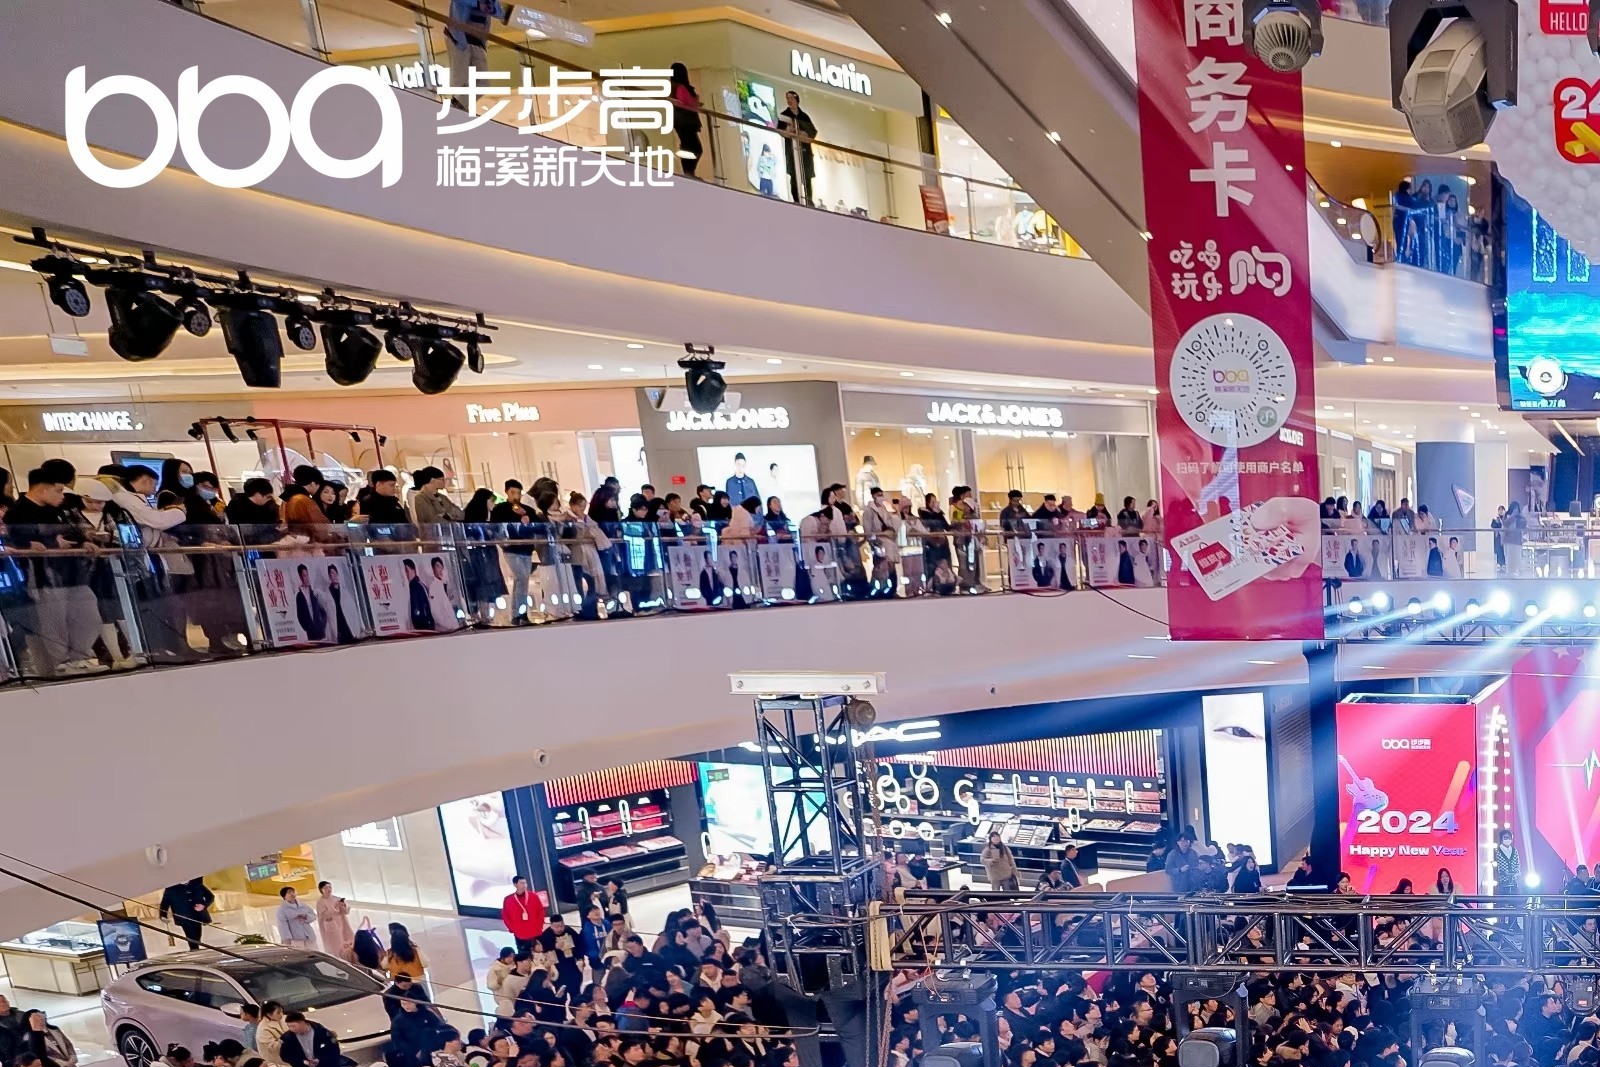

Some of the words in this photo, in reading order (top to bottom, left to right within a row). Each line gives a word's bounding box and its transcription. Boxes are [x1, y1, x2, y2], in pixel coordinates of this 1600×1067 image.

[1550, 12, 1588, 32] HELLO
[791, 49, 872, 96] M.latin
[1184, 0, 1256, 217] 商务卡
[1169, 240, 1221, 270] 吃喝
[1228, 246, 1292, 297] 购
[1171, 272, 1223, 302] 玩乐
[42, 411, 133, 432] INTERCHANGE
[466, 403, 500, 424] Five
[501, 405, 539, 422] Plus
[666, 406, 790, 431] JACK&JONES
[926, 401, 1064, 427] JACK&JONES
[1356, 809, 1459, 835] 2024
[1350, 844, 1396, 858] Happy
[1399, 844, 1429, 856] New
[1432, 845, 1467, 856] Year
